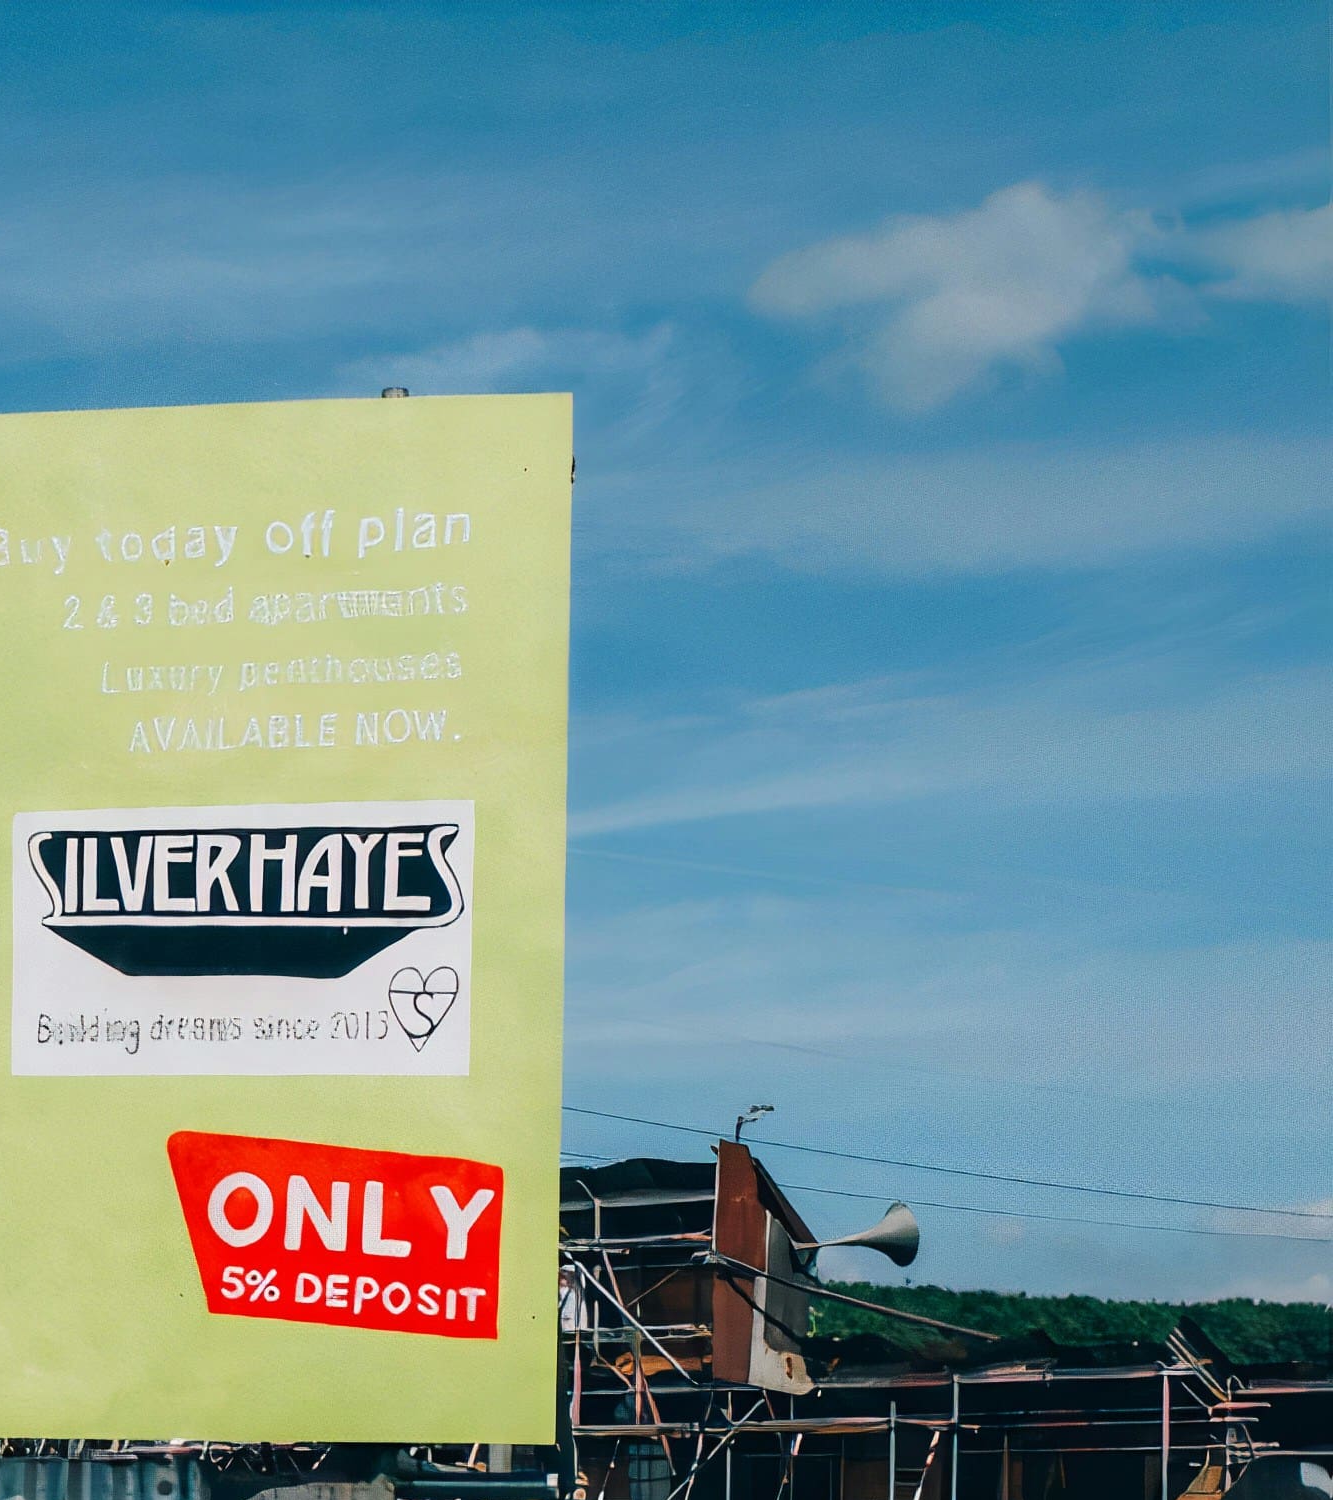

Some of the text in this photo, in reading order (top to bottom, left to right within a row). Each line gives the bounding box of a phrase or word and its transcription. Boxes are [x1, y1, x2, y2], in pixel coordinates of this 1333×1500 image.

[95, 525, 238, 567] today
[265, 509, 335, 557] off
[358, 507, 471, 558] plan
[63, 596, 83, 630] 2
[96, 595, 120, 629] &
[135, 594, 153, 625] 3
[168, 587, 233, 626] bed
[102, 651, 462, 696] Luxury penthouses
[130, 710, 462, 752] AVAILABLE NOW.
[28, 824, 465, 928] SILVERHAYES
[149, 1014, 241, 1041] dreams
[254, 1013, 319, 1041] since
[331, 1010, 389, 1041] 2013
[207, 1172, 495, 1260] ONLY
[220, 1265, 487, 1323] 5% DEPOSIT
